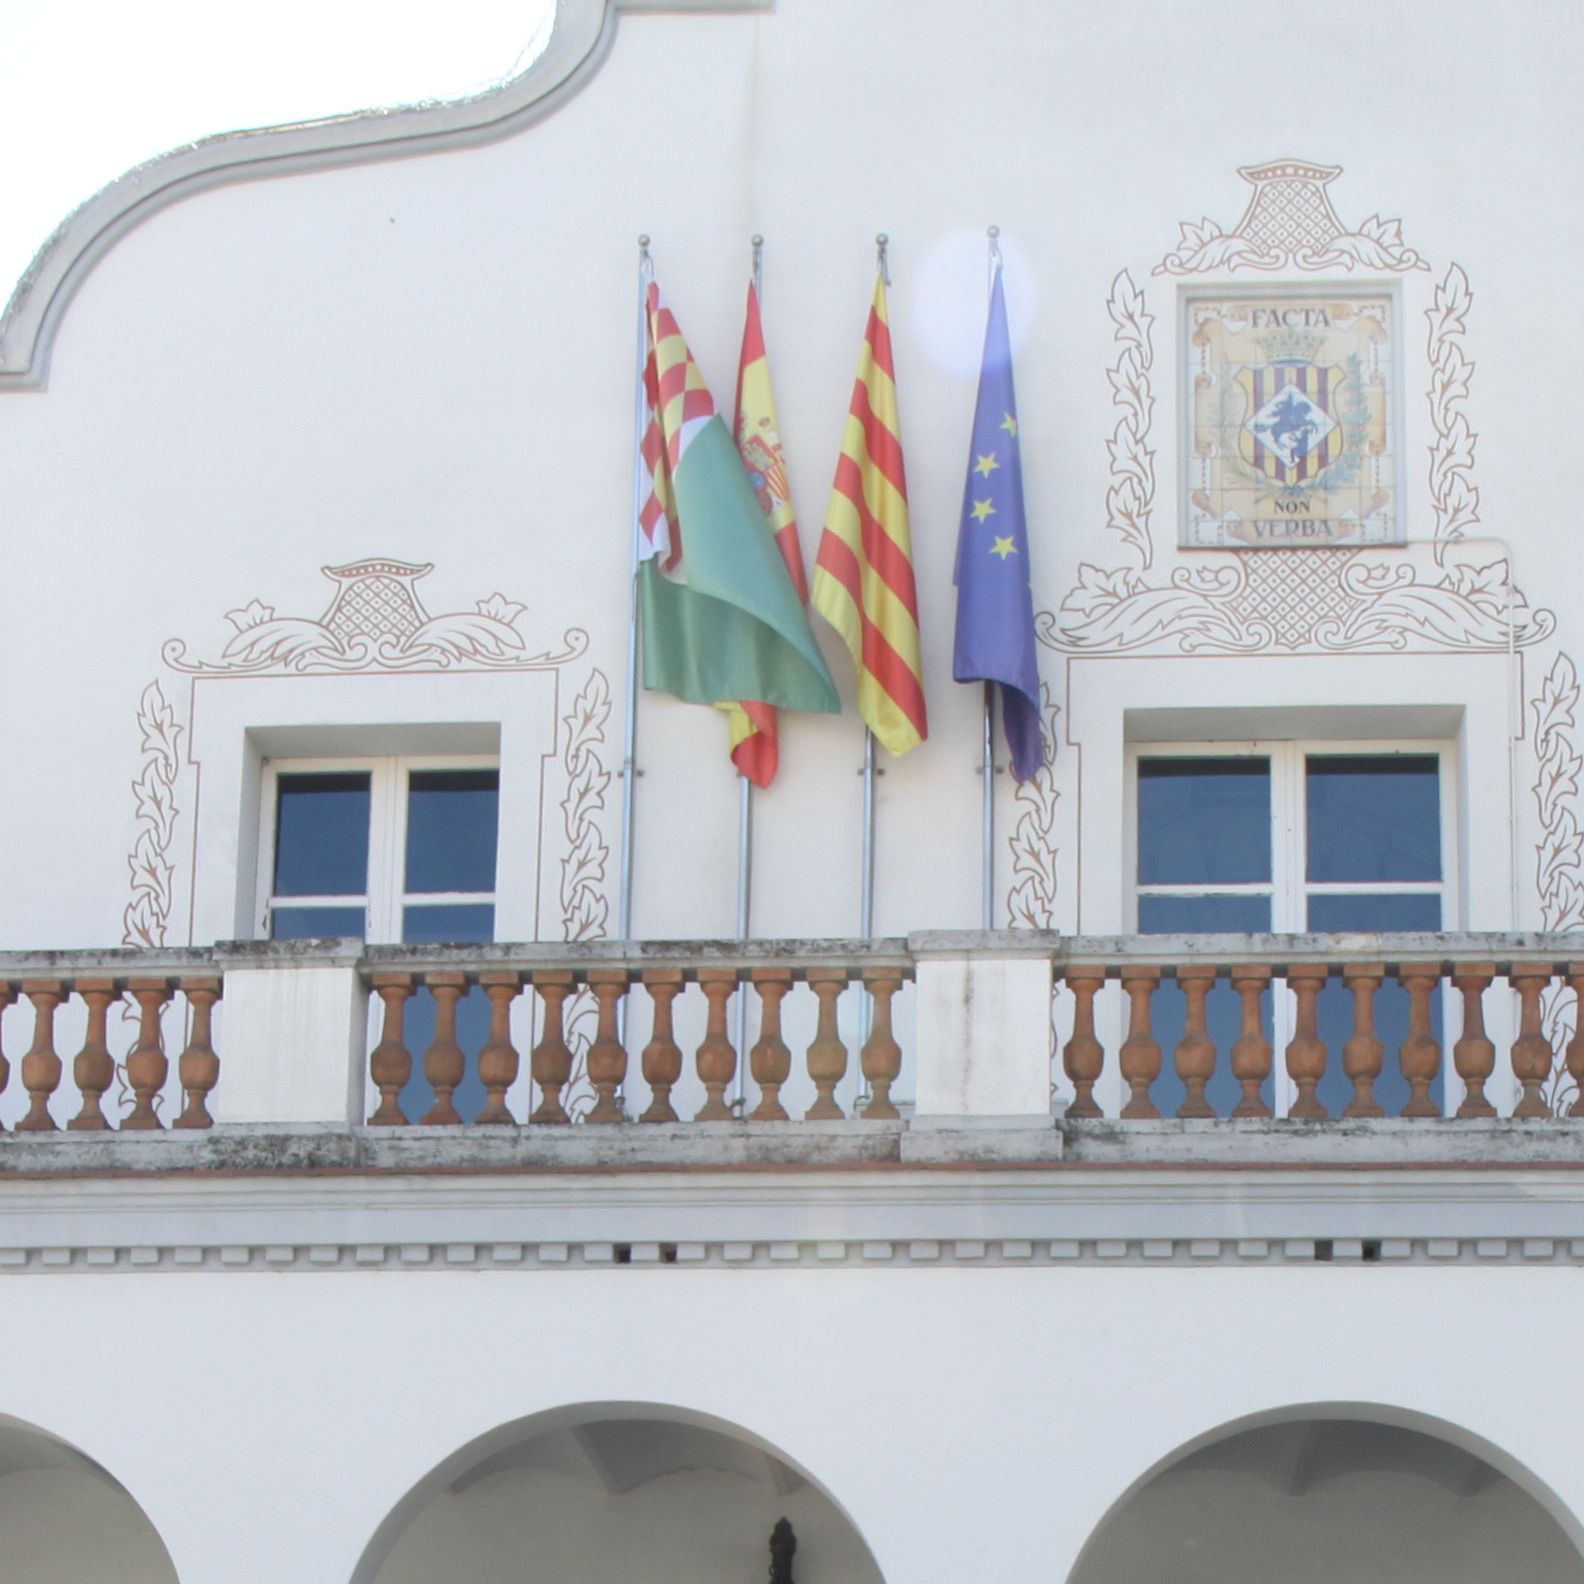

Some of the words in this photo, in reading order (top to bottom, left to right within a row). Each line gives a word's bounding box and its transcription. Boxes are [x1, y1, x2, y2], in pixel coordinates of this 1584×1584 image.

[1251, 308, 1331, 328] FACTA
[1273, 500, 1311, 514] NON
[1252, 519, 1334, 539] VERBA
